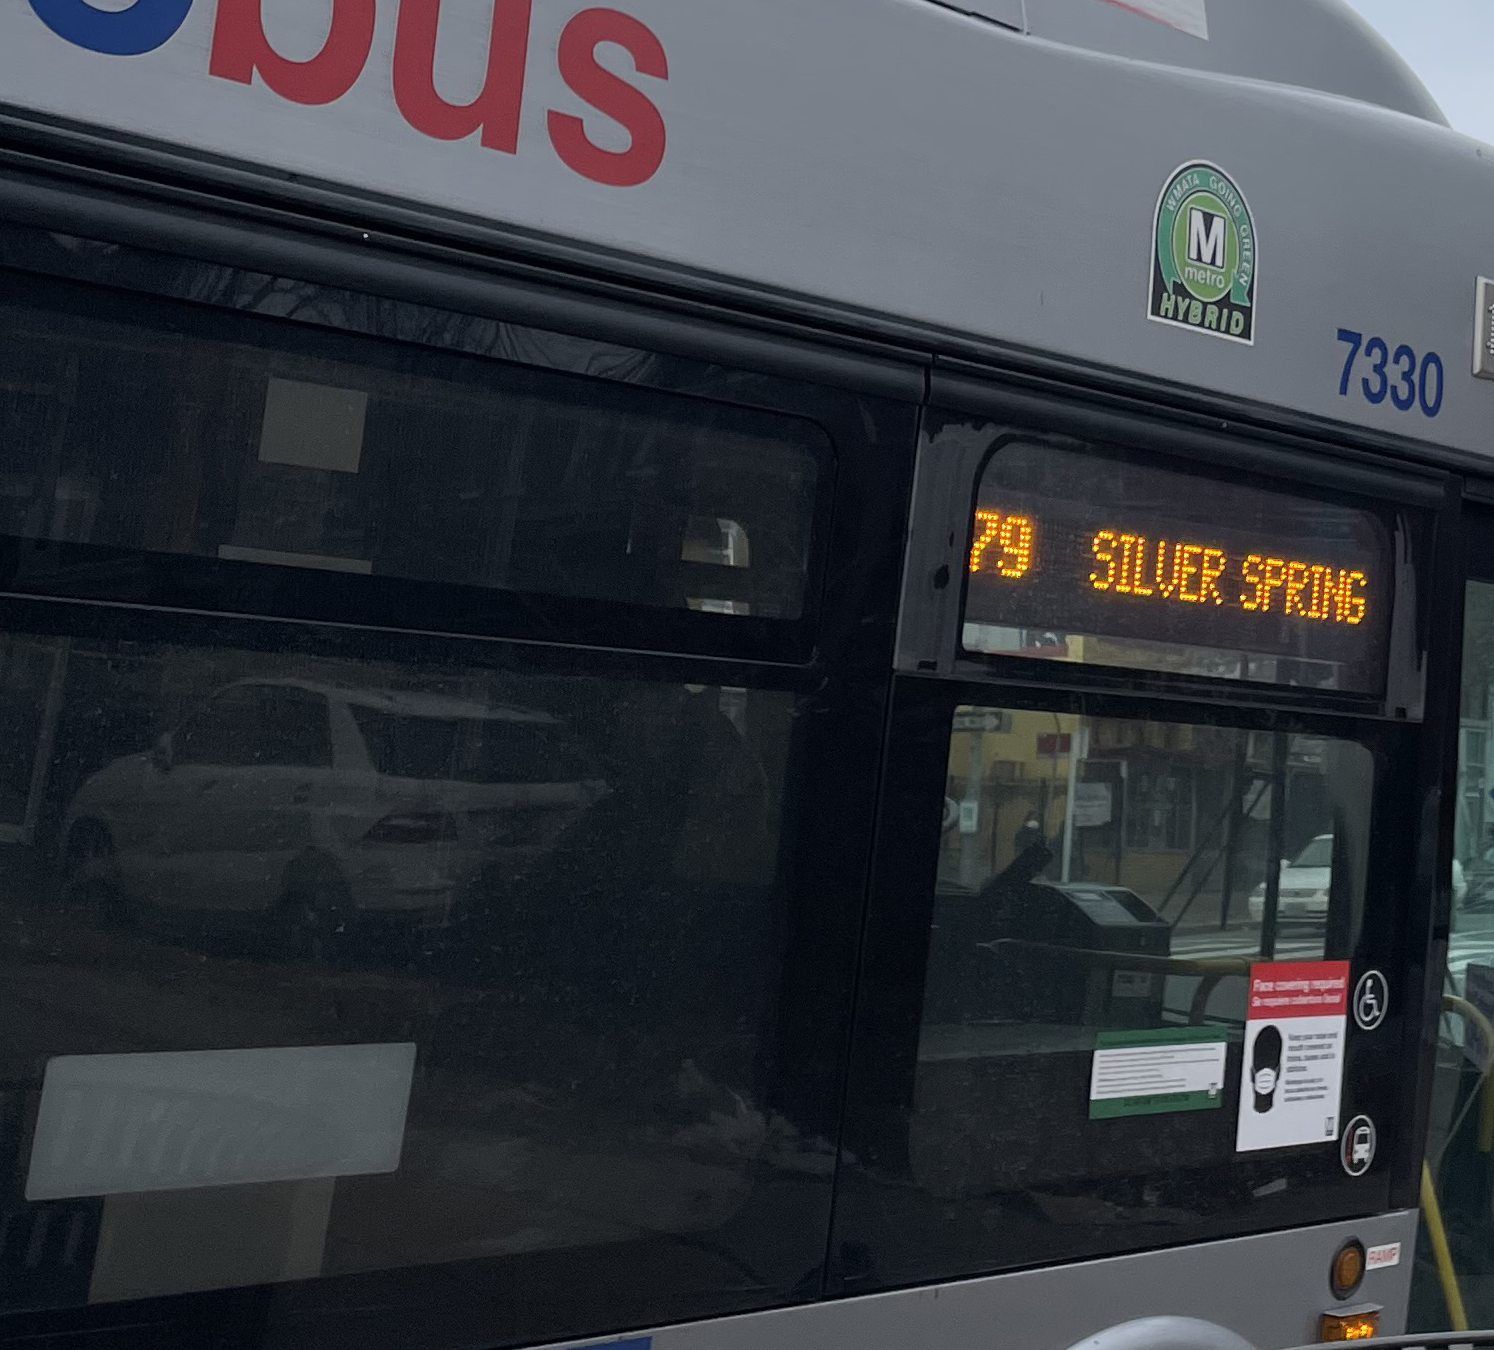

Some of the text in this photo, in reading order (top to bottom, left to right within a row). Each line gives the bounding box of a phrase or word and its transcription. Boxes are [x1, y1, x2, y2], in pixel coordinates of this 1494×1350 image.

[1166, 172, 1251, 287] WMATA GOING GREEN
[1188, 207, 1226, 270] M
[1159, 292, 1245, 336] HYBRID
[1184, 266, 1226, 290] metro
[1336, 327, 1444, 418] 7330
[968, 508, 1368, 626] 79 SILVER SPRING
